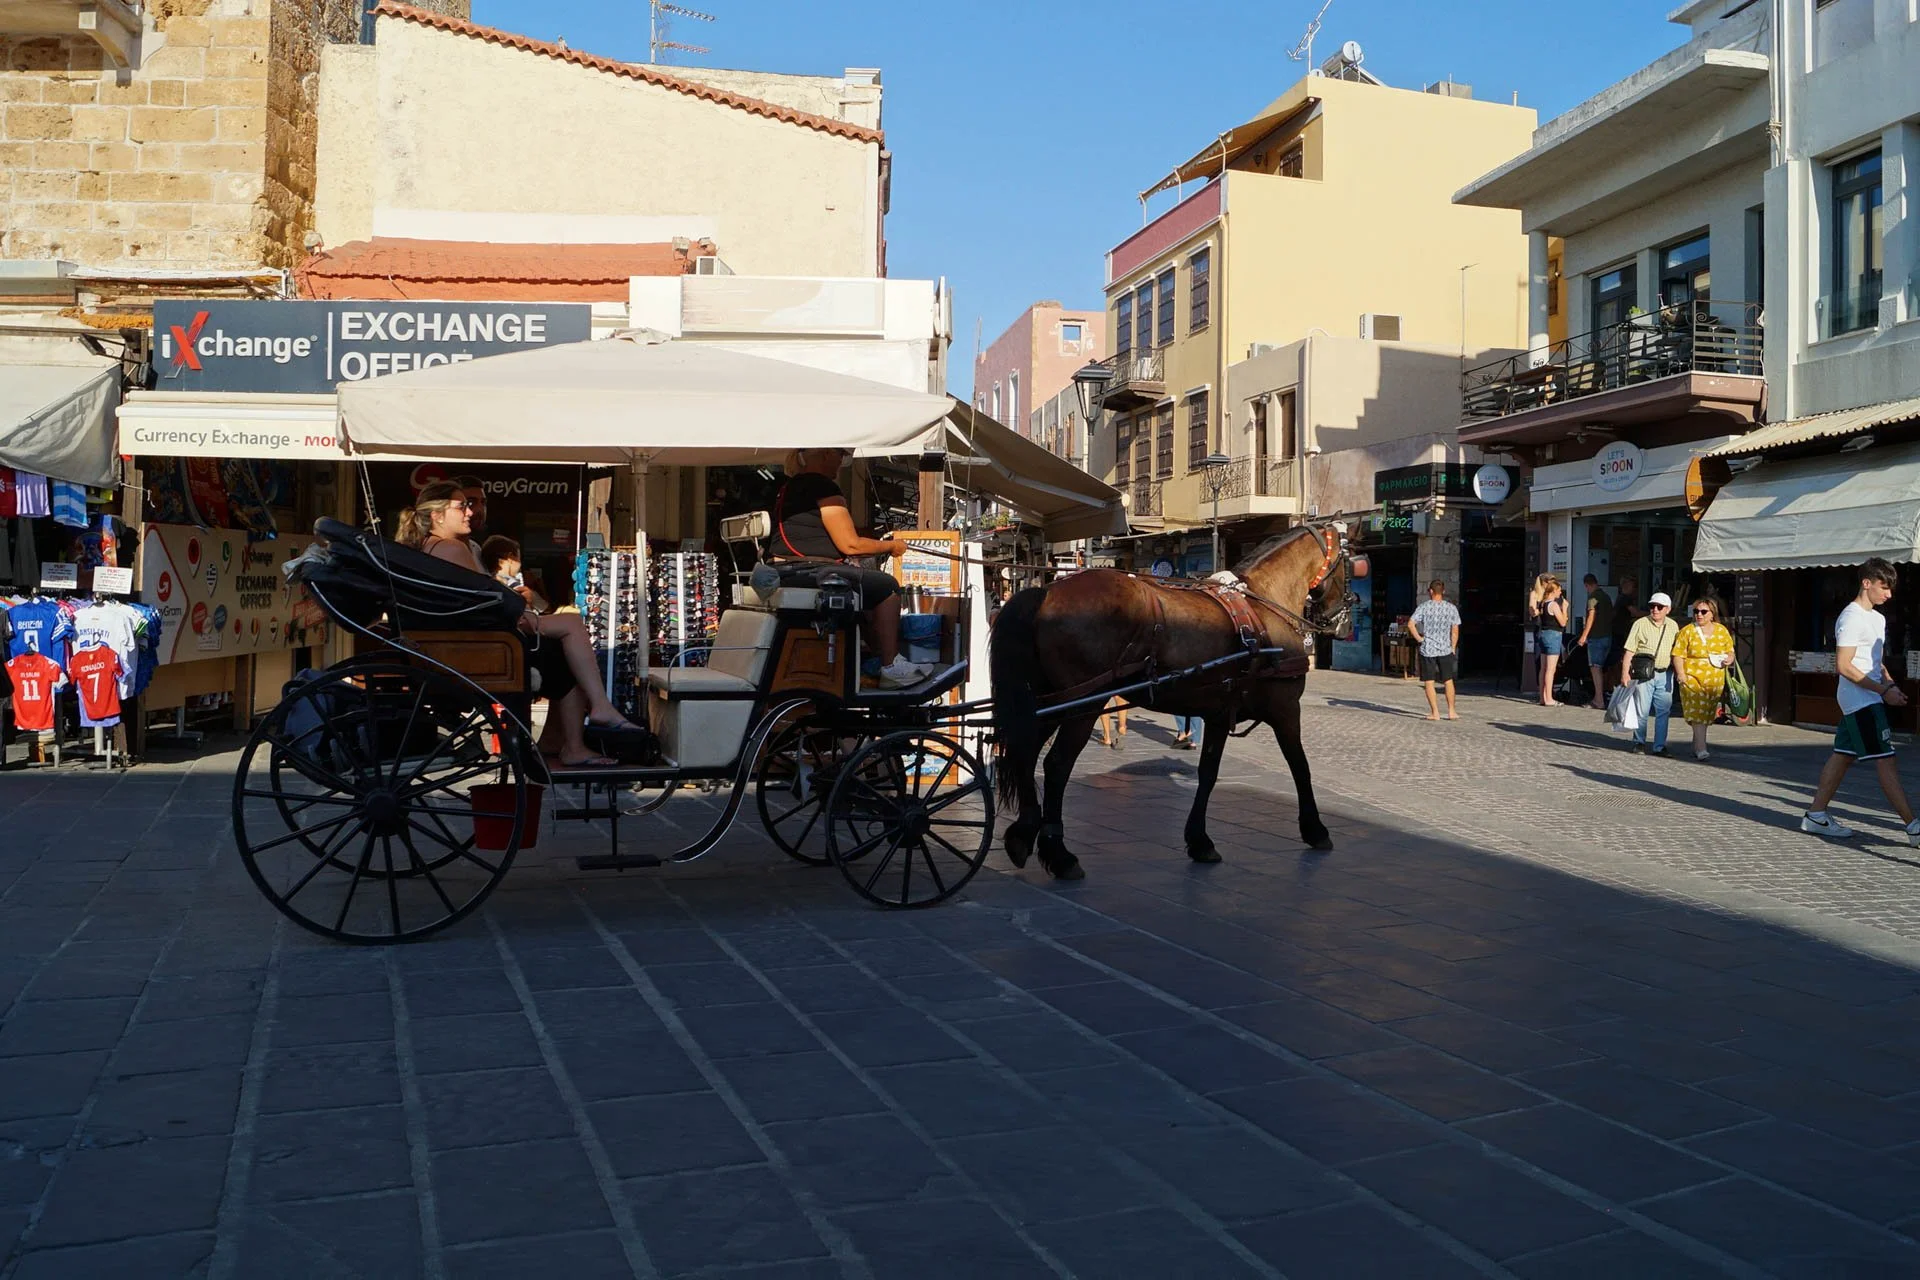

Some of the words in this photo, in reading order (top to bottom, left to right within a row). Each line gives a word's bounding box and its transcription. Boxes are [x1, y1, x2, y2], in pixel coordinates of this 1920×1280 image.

[341, 311, 547, 342] EXCHANGE
[339, 351, 473, 381] OFFI
[134, 427, 207, 447] Currency
[212, 429, 290, 449] Exchange
[1600, 458, 1633, 475] SPOON
[482, 477, 569, 497] neyGram
[1378, 474, 1428, 492] ΦΑΡΜΑΚΕΙΟ
[236, 576, 278, 592] EXCHANGE
[240, 593, 272, 609] OFFICES
[24, 630, 40, 652] 9
[22, 679, 41, 701] 11
[87, 673, 100, 704] 7
